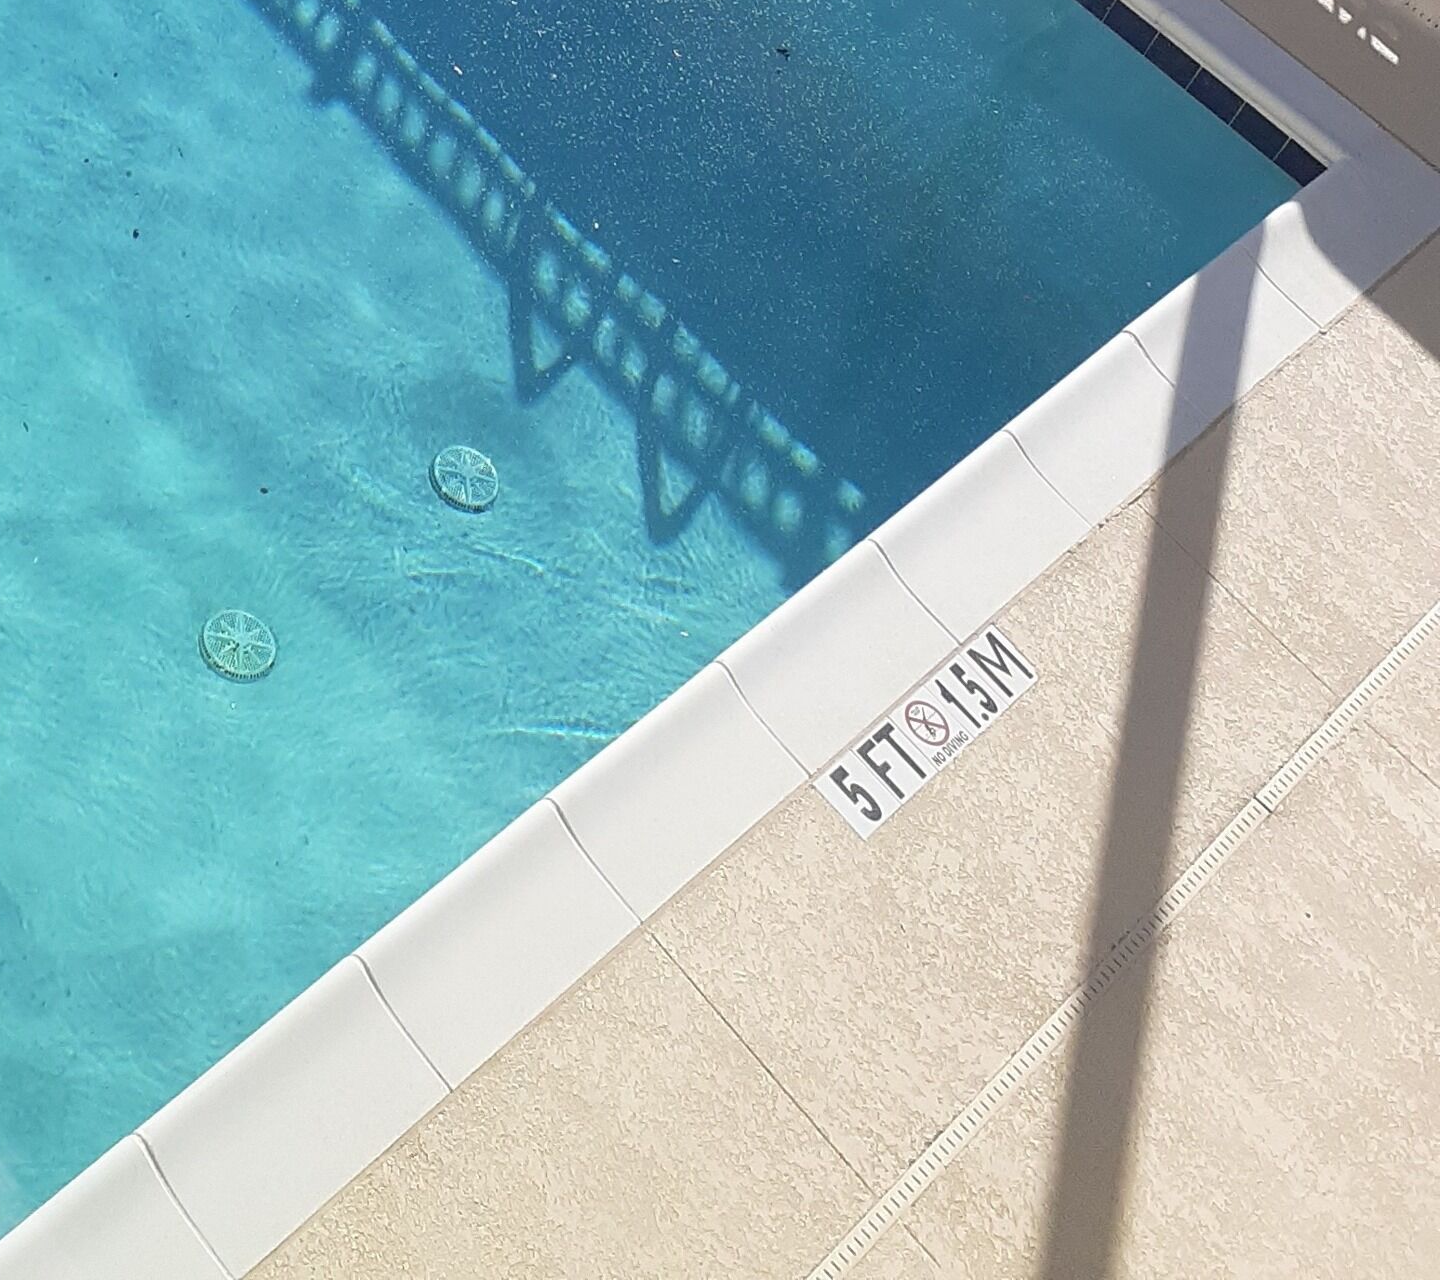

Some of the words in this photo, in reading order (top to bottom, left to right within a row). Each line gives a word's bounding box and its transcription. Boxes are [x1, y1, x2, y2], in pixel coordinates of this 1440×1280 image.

[829, 765, 882, 822] 5
[856, 722, 927, 800] FT
[931, 750, 947, 767] NO
[946, 730, 969, 758] DIVING
